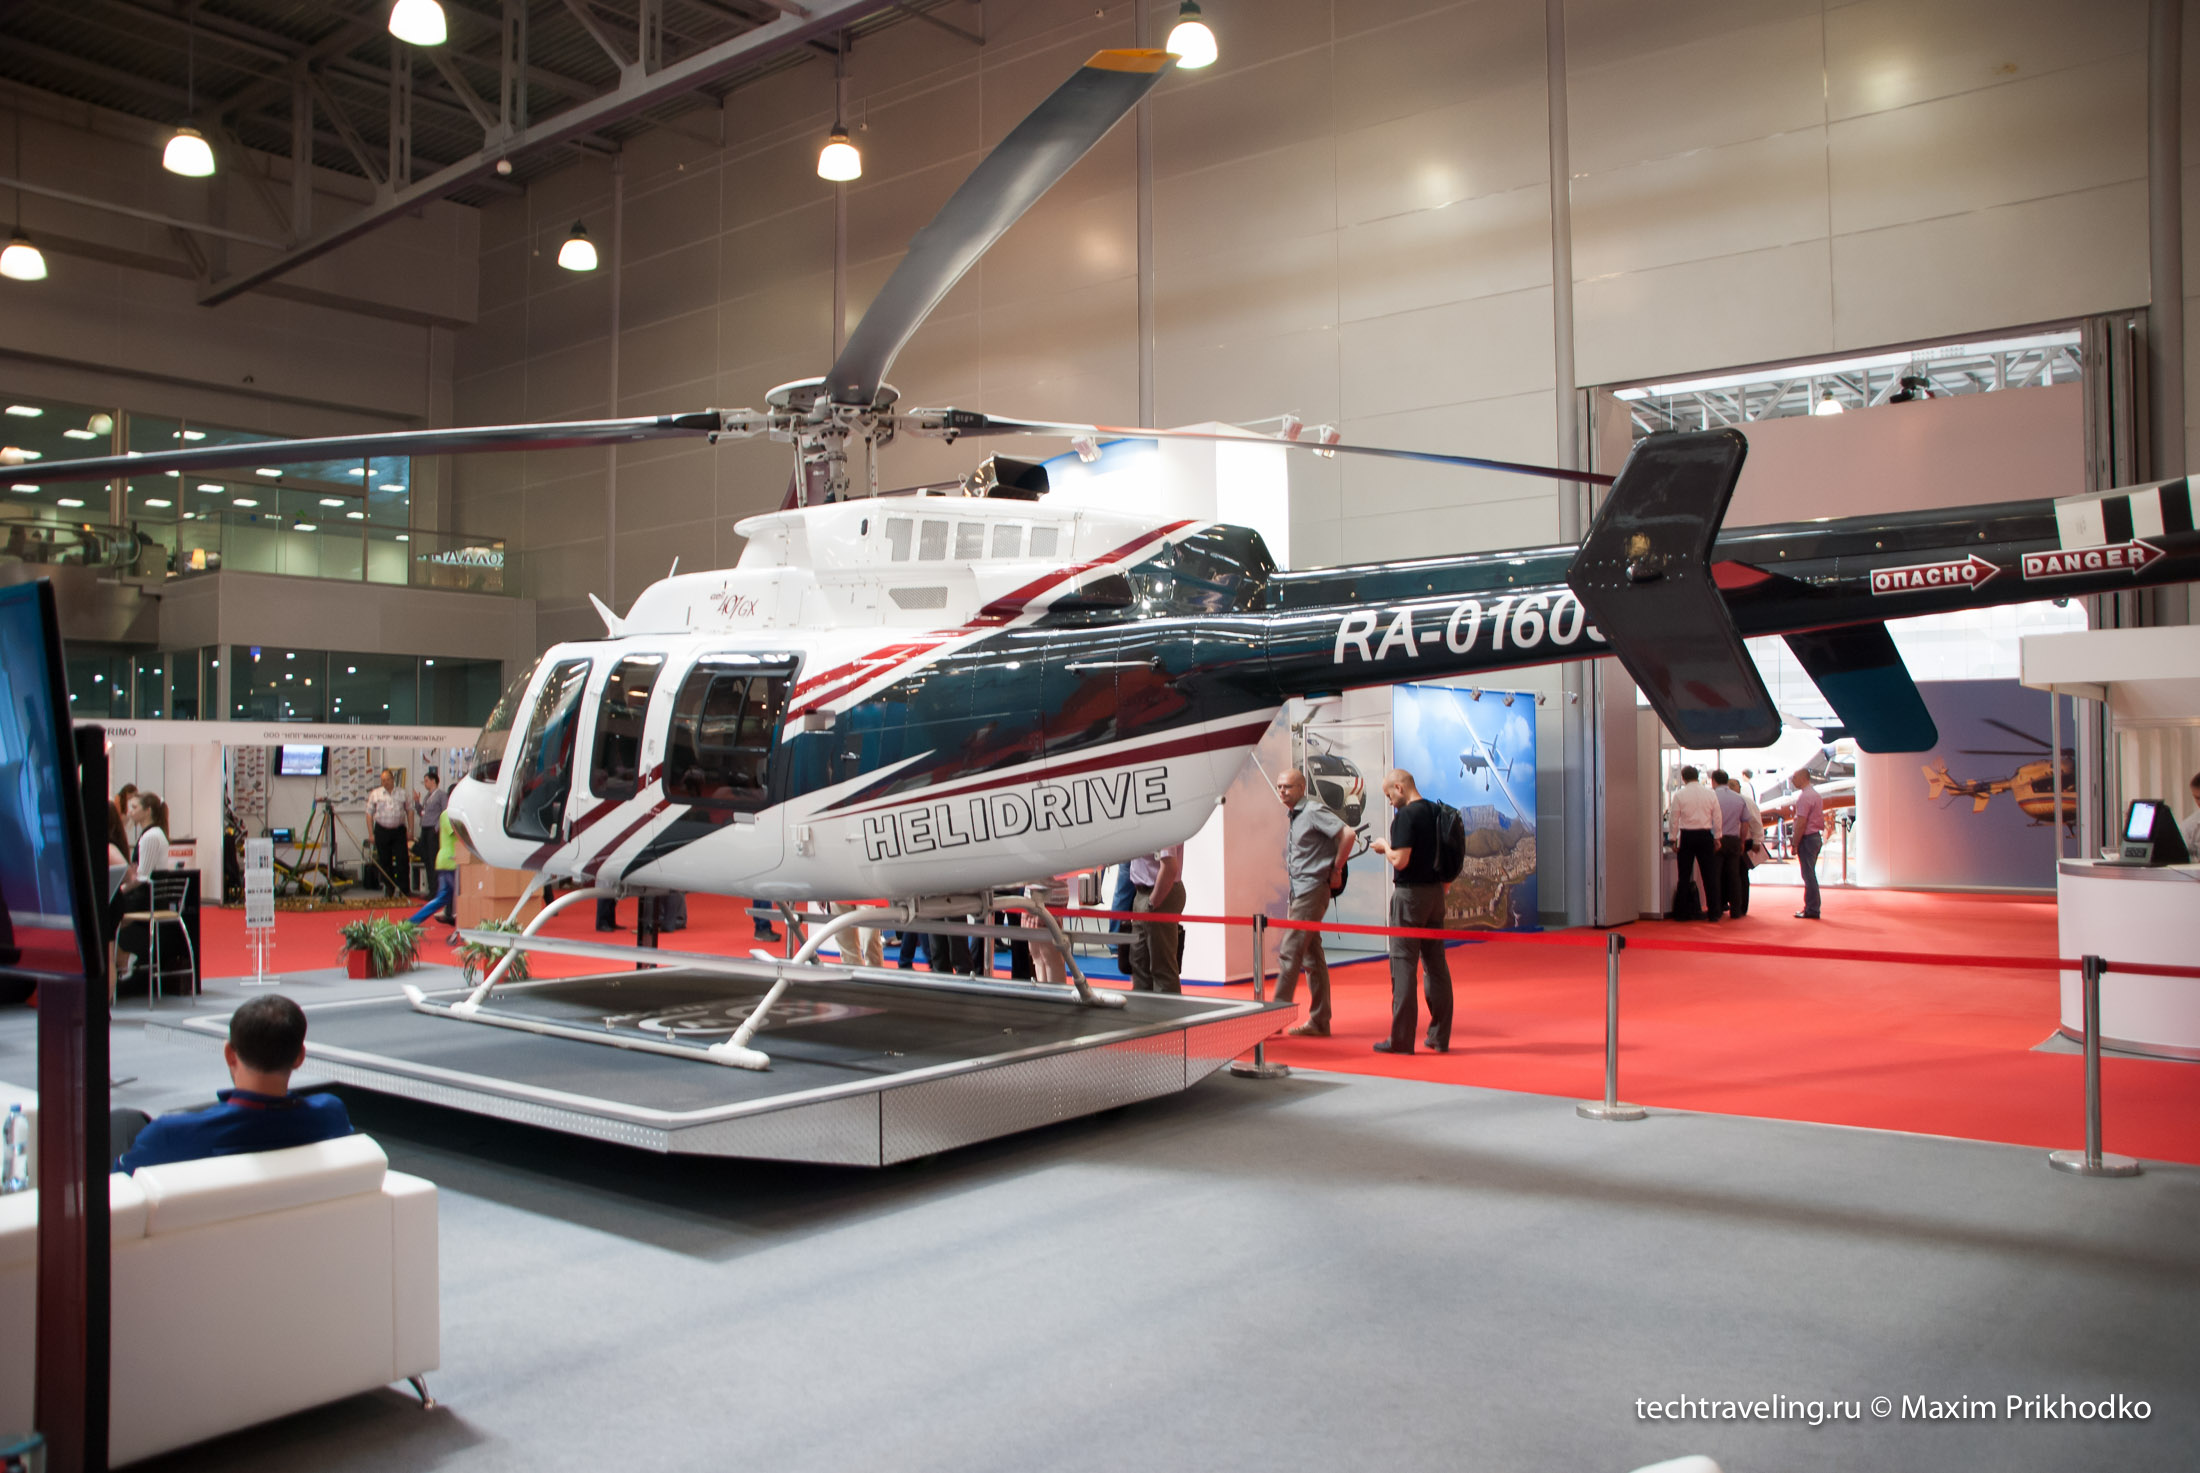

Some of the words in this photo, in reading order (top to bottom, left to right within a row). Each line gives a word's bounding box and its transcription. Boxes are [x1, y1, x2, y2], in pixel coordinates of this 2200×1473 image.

[2026, 547, 2146, 575] DANGER
[1875, 564, 1978, 590] ОПАСНО
[863, 766, 1171, 861] HELIDRIVE
